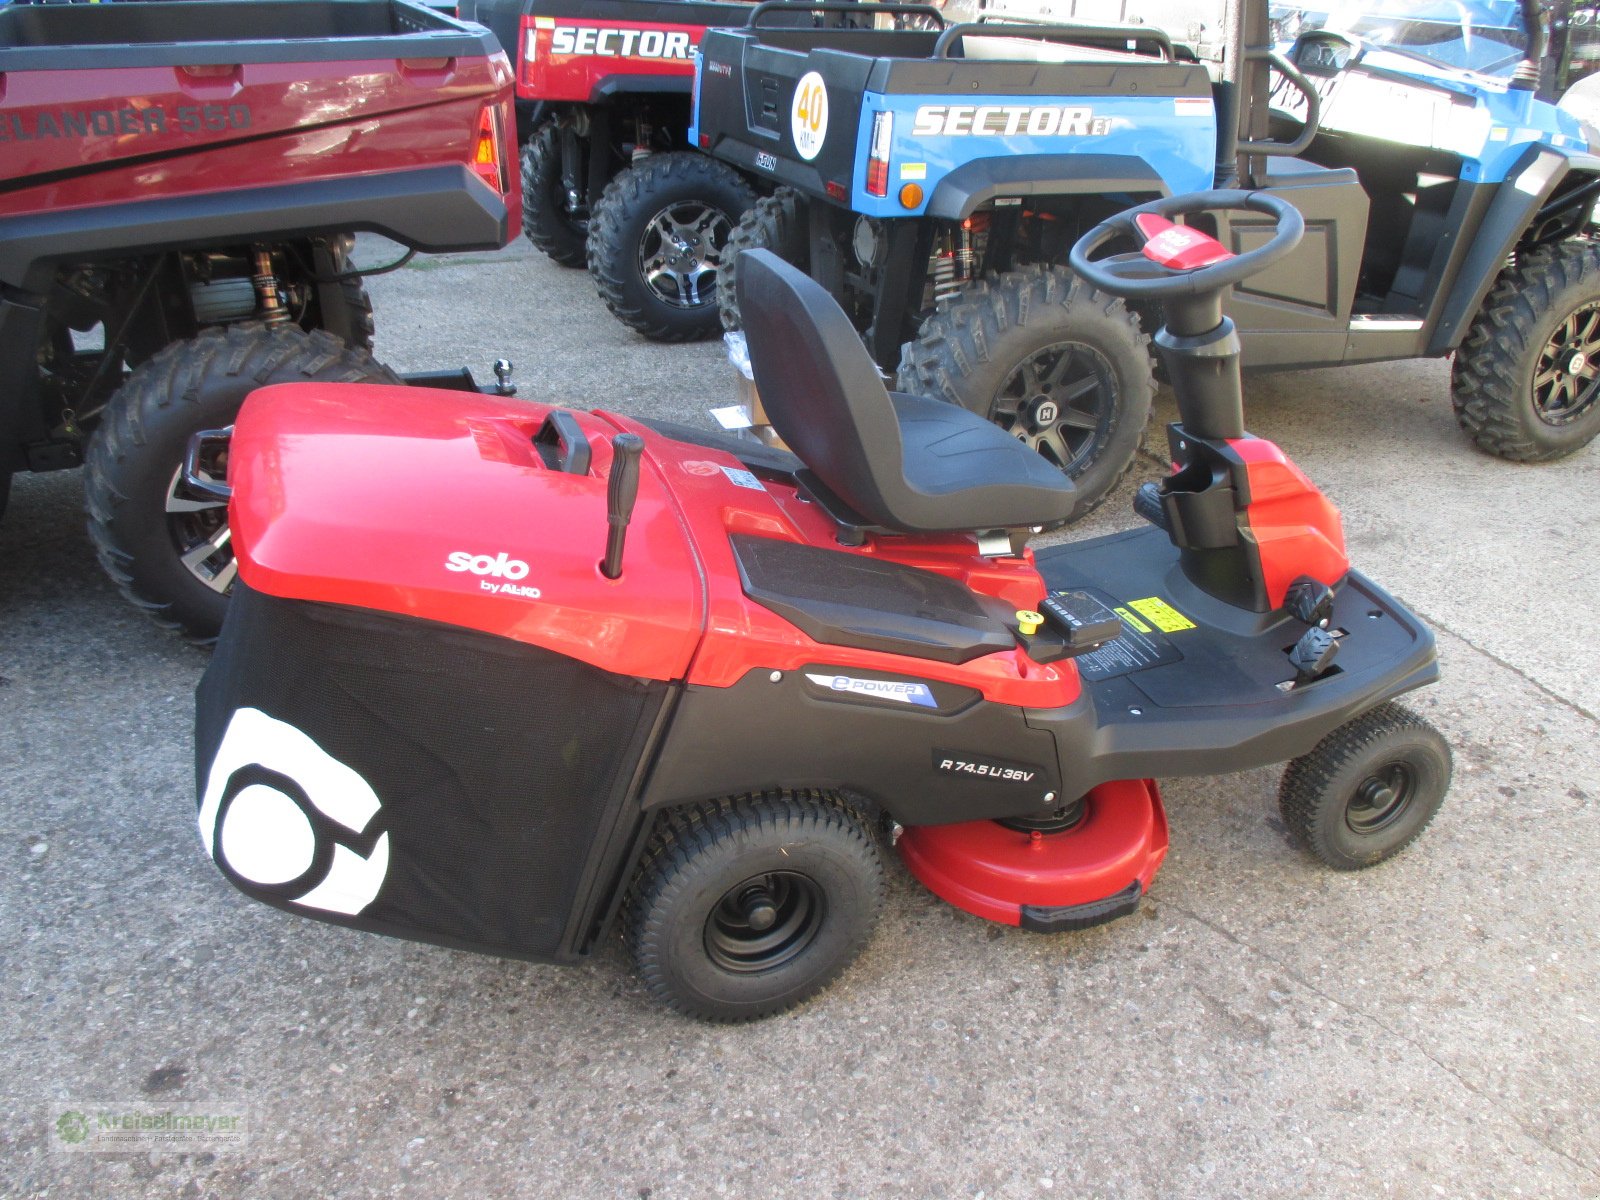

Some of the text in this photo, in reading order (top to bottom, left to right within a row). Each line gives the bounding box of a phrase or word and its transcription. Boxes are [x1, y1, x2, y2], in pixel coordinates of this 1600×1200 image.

[551, 26, 689, 58] SECTOR
[178, 104, 251, 132] 550
[797, 82, 823, 132] 40
[912, 104, 1113, 136] SECTOR E1
[445, 551, 530, 580] solo
[480, 580, 501, 593] by
[852, 680, 917, 694] POWER
[940, 759, 1035, 782] R 74.5 Li 36V
